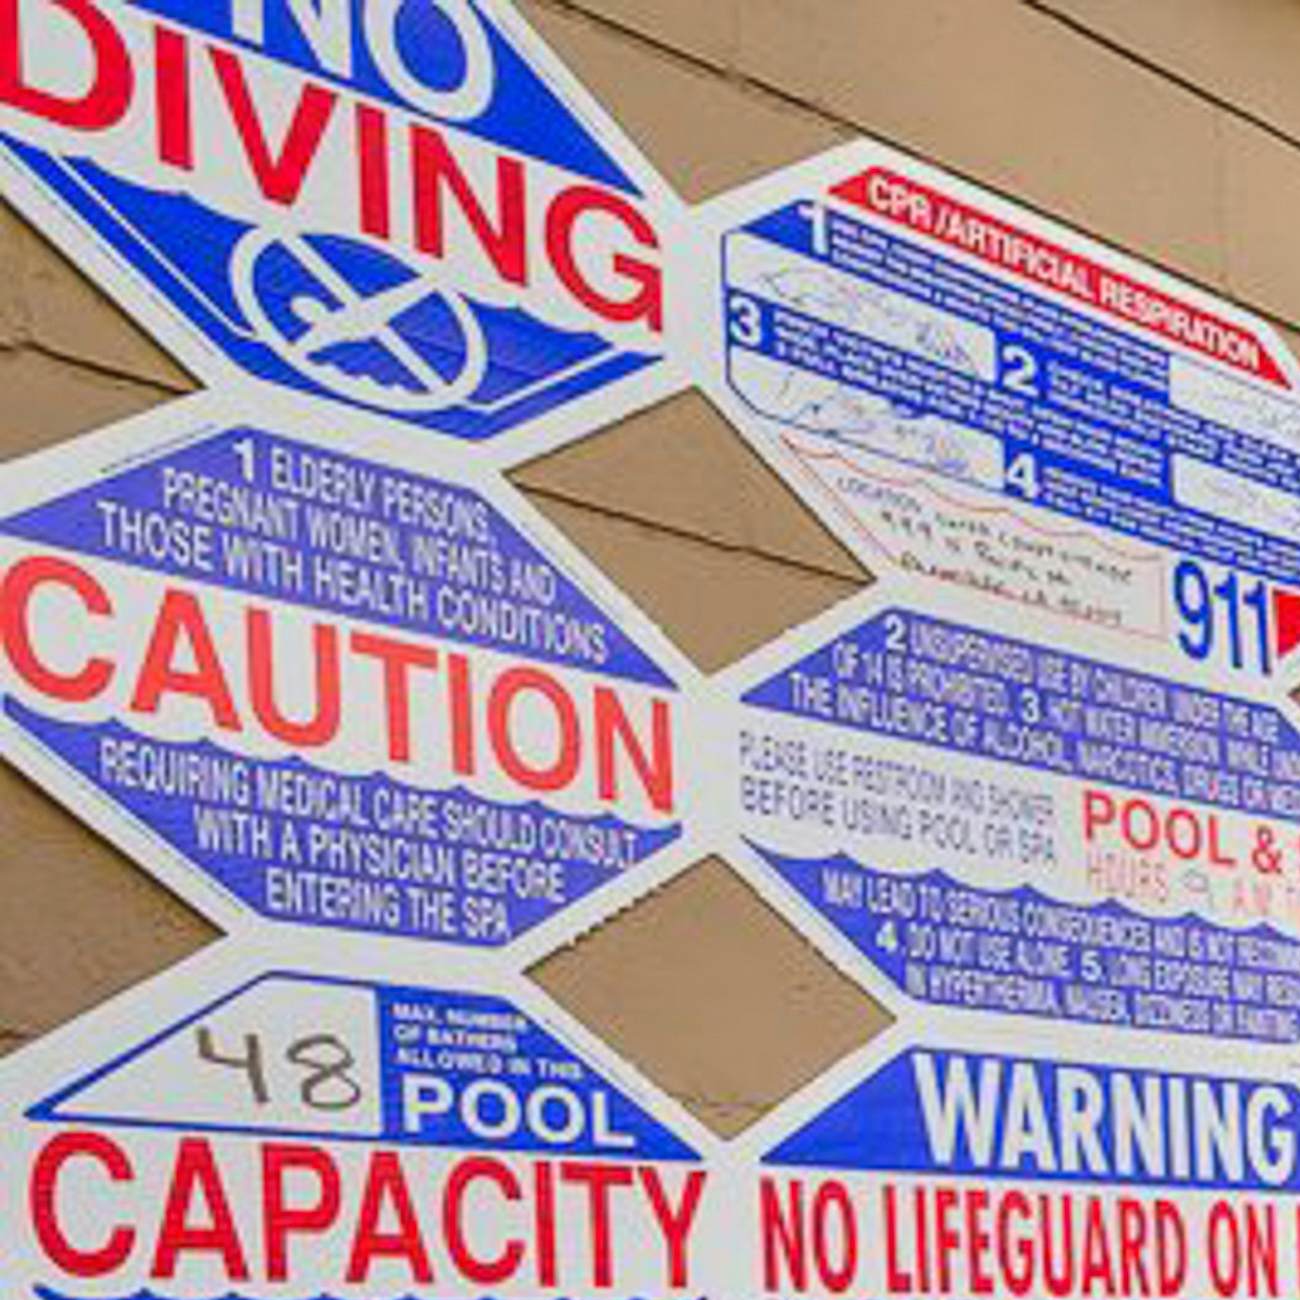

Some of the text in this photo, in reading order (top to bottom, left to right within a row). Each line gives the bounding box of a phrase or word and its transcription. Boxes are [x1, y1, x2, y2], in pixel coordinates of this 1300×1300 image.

[0, 0, 663, 333] DIVING
[797, 202, 828, 256] 1
[730, 296, 763, 346] 3
[1100, 273, 1261, 377] RESPIRATION
[1001, 343, 1039, 396] 2
[233, 438, 255, 482] 1
[271, 446, 373, 503] ELDERLY
[1006, 452, 1037, 498] 4
[163, 468, 300, 543] PREGNANT
[413, 534, 501, 590] INFANTS
[507, 556, 556, 602] AND
[98, 499, 608, 663] THOSE WITH HEALTH CONDITIONS
[1172, 558, 1273, 677] 911
[0, 554, 674, 814] CAUTION
[789, 671, 832, 714] THE
[837, 682, 948, 741] INFLUENCE
[953, 708, 979, 748] OF
[101, 737, 641, 871] REQUIRING MEDICAL CARE SHOULD CONSULT
[741, 773, 1055, 868] BEFORE USING POOL OR SPA
[1081, 790, 1237, 868] POOL
[1251, 823, 1283, 876] &
[196, 805, 565, 903] WITH A PHYSICIAN BEFORE
[867, 875, 916, 917] LEAD
[266, 874, 509, 940] ENTERING THE SPA
[193, 1024, 363, 1111] 48
[392, 1023, 421, 1045] OF
[394, 1047, 502, 1075] ALLOWED
[400, 1074, 636, 1149] POOL
[909, 1051, 1298, 1185] WARNING
[28, 1130, 707, 1289] CAPACITY
[760, 1176, 858, 1295] NO
[884, 1182, 1188, 1299] LIFEGUARD
[1207, 1199, 1280, 1300] ON
